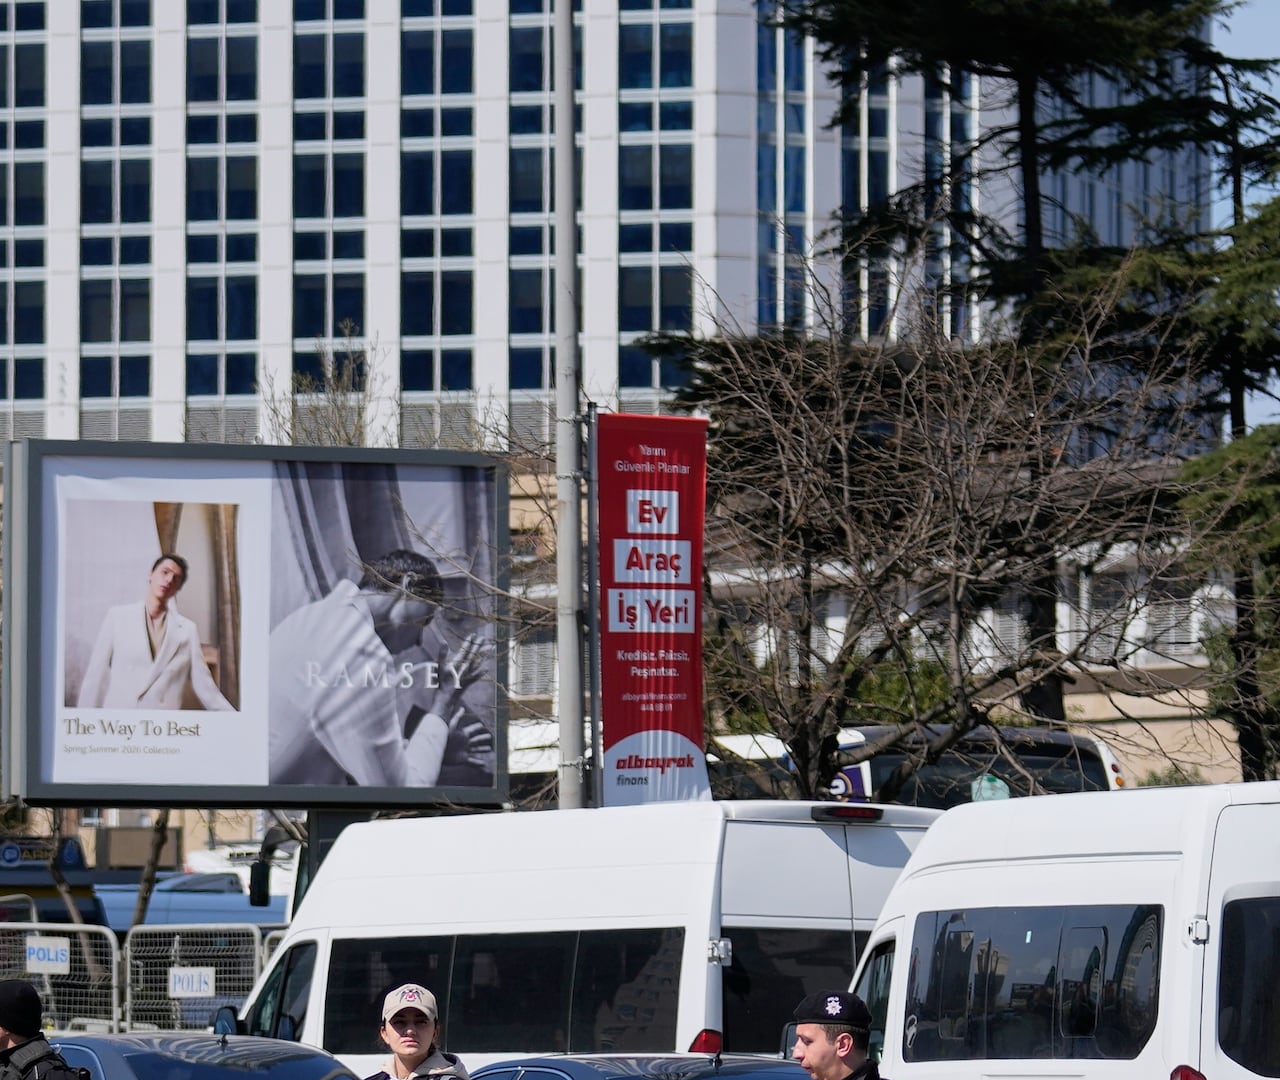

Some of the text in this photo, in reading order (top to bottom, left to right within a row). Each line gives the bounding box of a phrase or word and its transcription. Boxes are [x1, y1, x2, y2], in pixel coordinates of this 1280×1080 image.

[615, 459, 655, 473] Güvenle
[637, 499, 668, 524] Ev
[625, 546, 682, 578] Araç
[618, 592, 689, 630] İş Yeri
[305, 660, 470, 690] RAMSEY
[64, 718, 202, 741] The Way To Best
[63, 744, 87, 755] Spring
[89, 745, 120, 754] Summer
[616, 754, 695, 775] albayrak
[616, 774, 649, 786] finans
[27, 946, 68, 963] POLİS
[173, 974, 209, 992] POLİS
